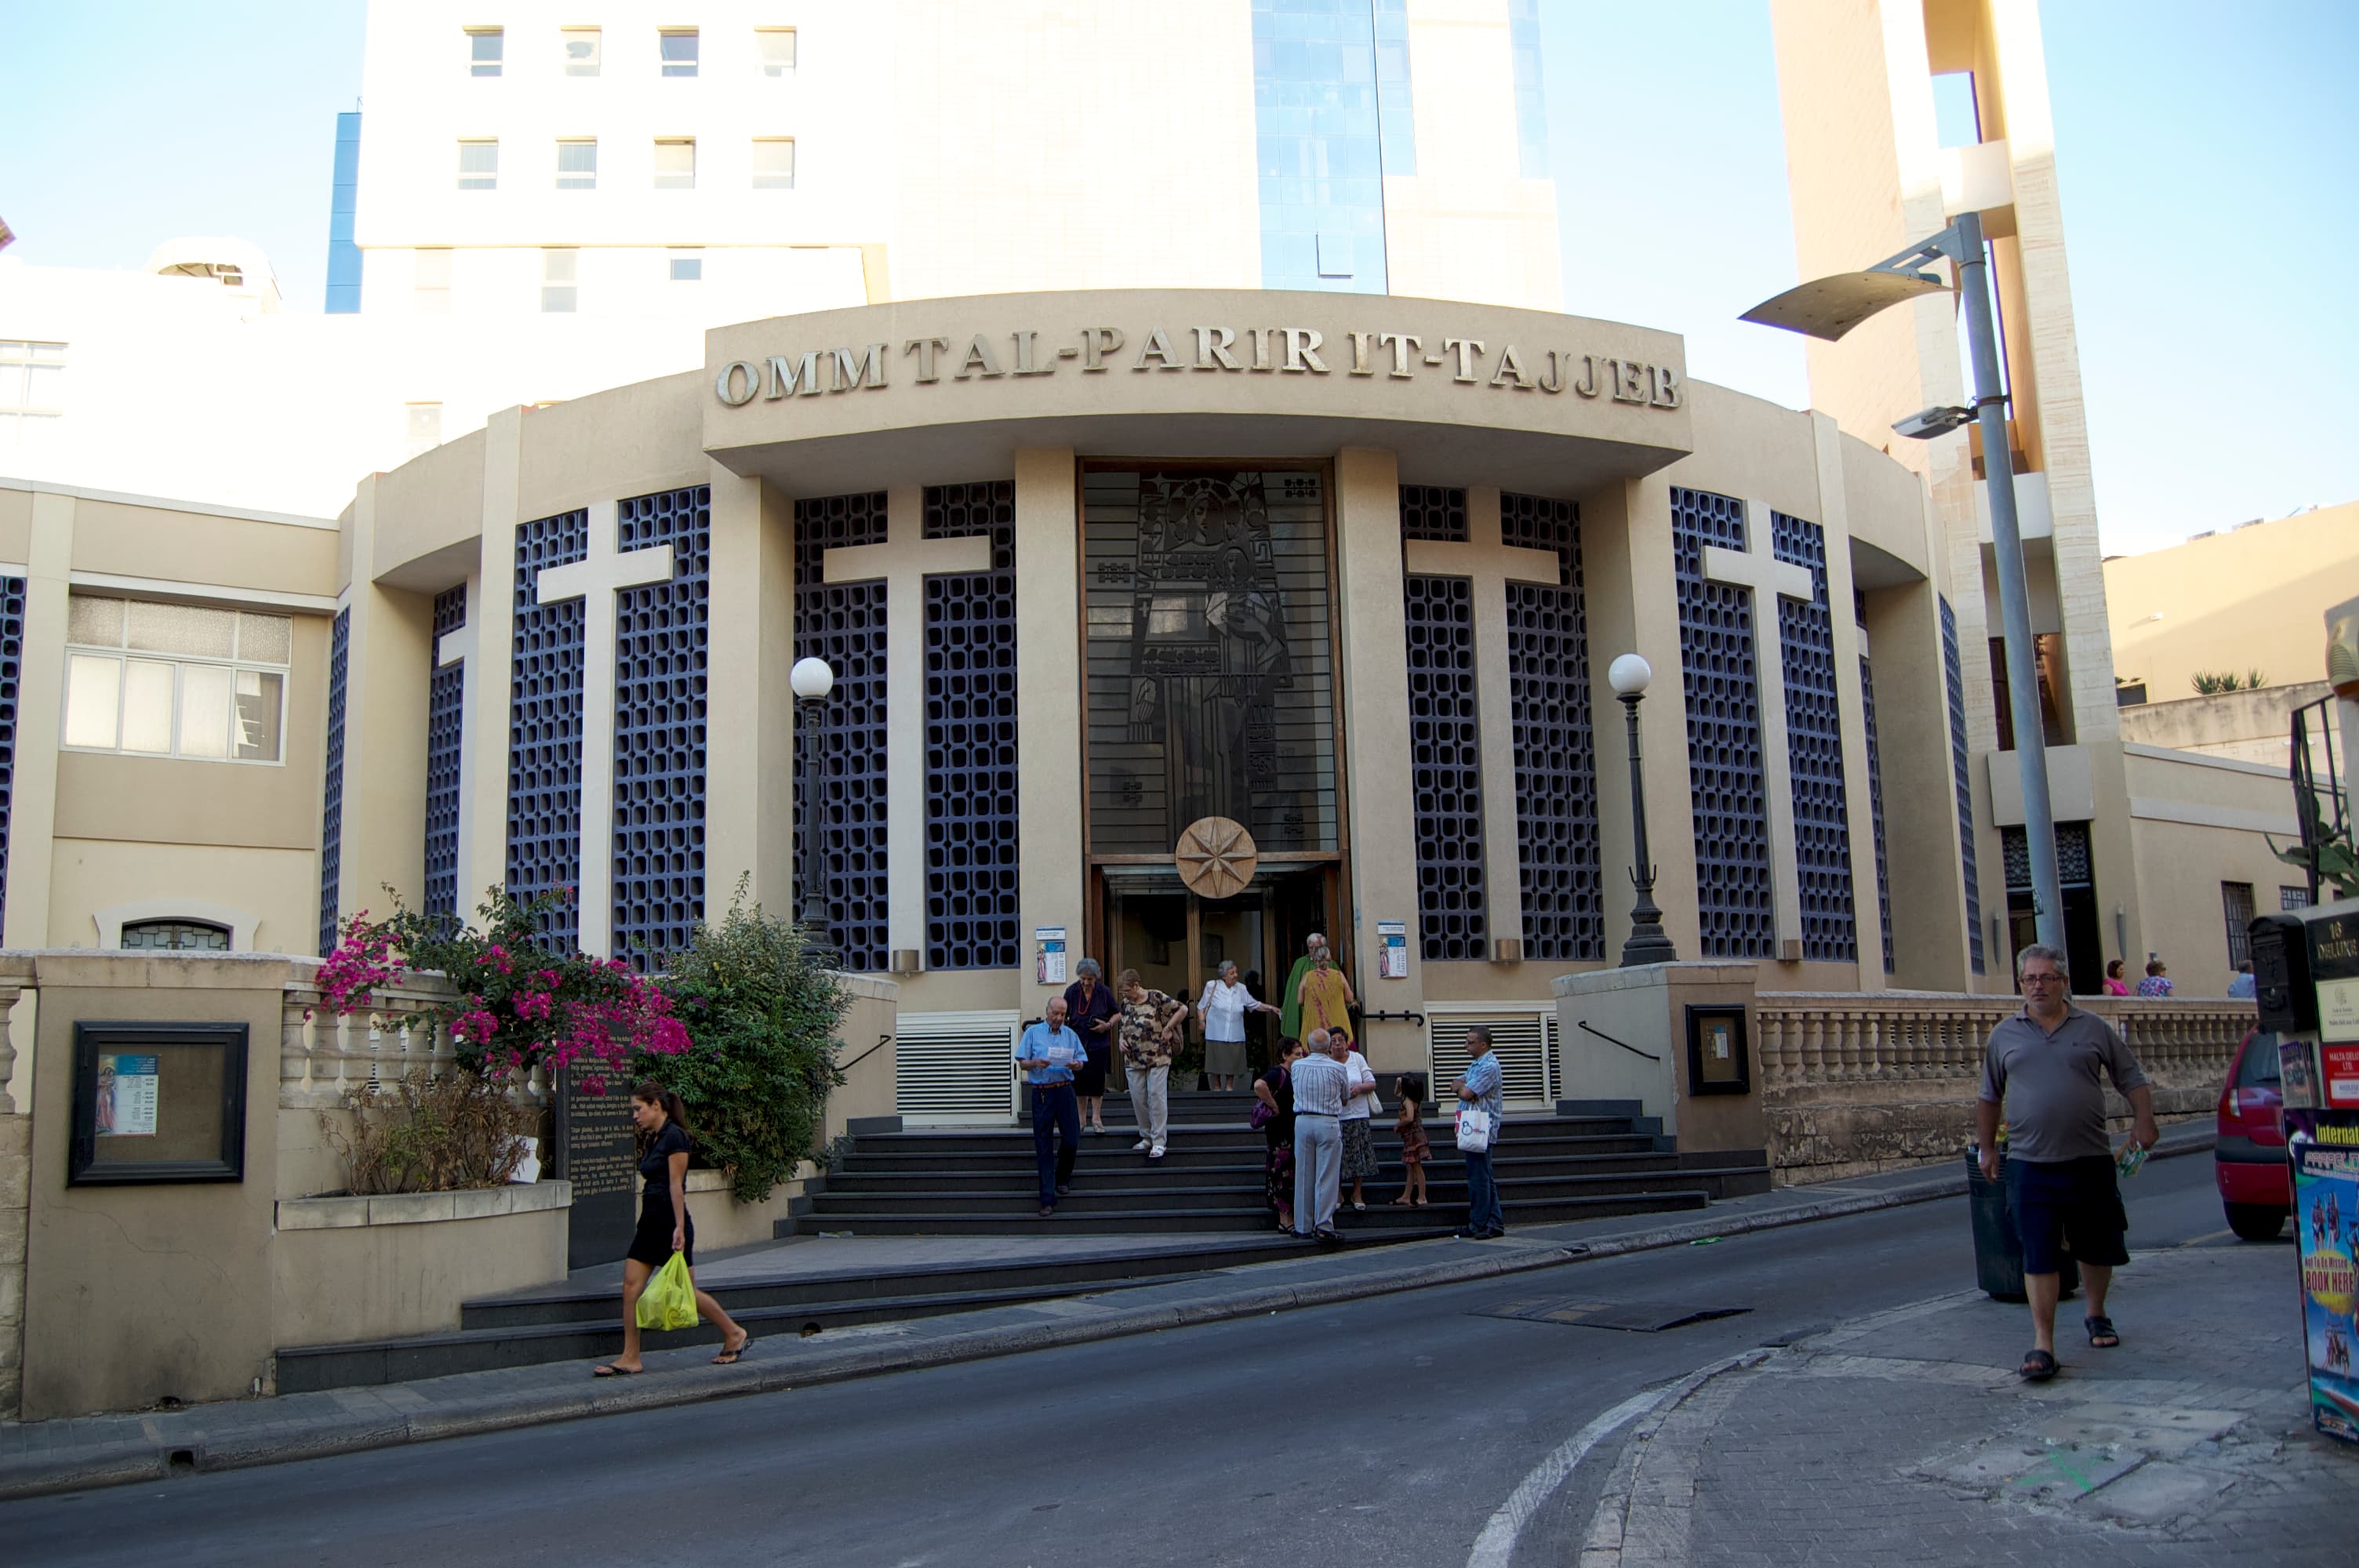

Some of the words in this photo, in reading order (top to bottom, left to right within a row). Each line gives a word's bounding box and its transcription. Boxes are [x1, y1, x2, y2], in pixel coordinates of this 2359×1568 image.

[715, 342, 889, 407] OMM
[904, 325, 1332, 384] TAL-PARIR
[1347, 330, 1683, 410] IT-TAJJEB
[2329, 1051, 2346, 1061] MALTA
[2314, 1257, 2320, 1268] To
[2328, 1256, 2347, 1269] Missed
[2306, 1270, 2330, 1292] BOOK
[2332, 1271, 2354, 1294] HERE
